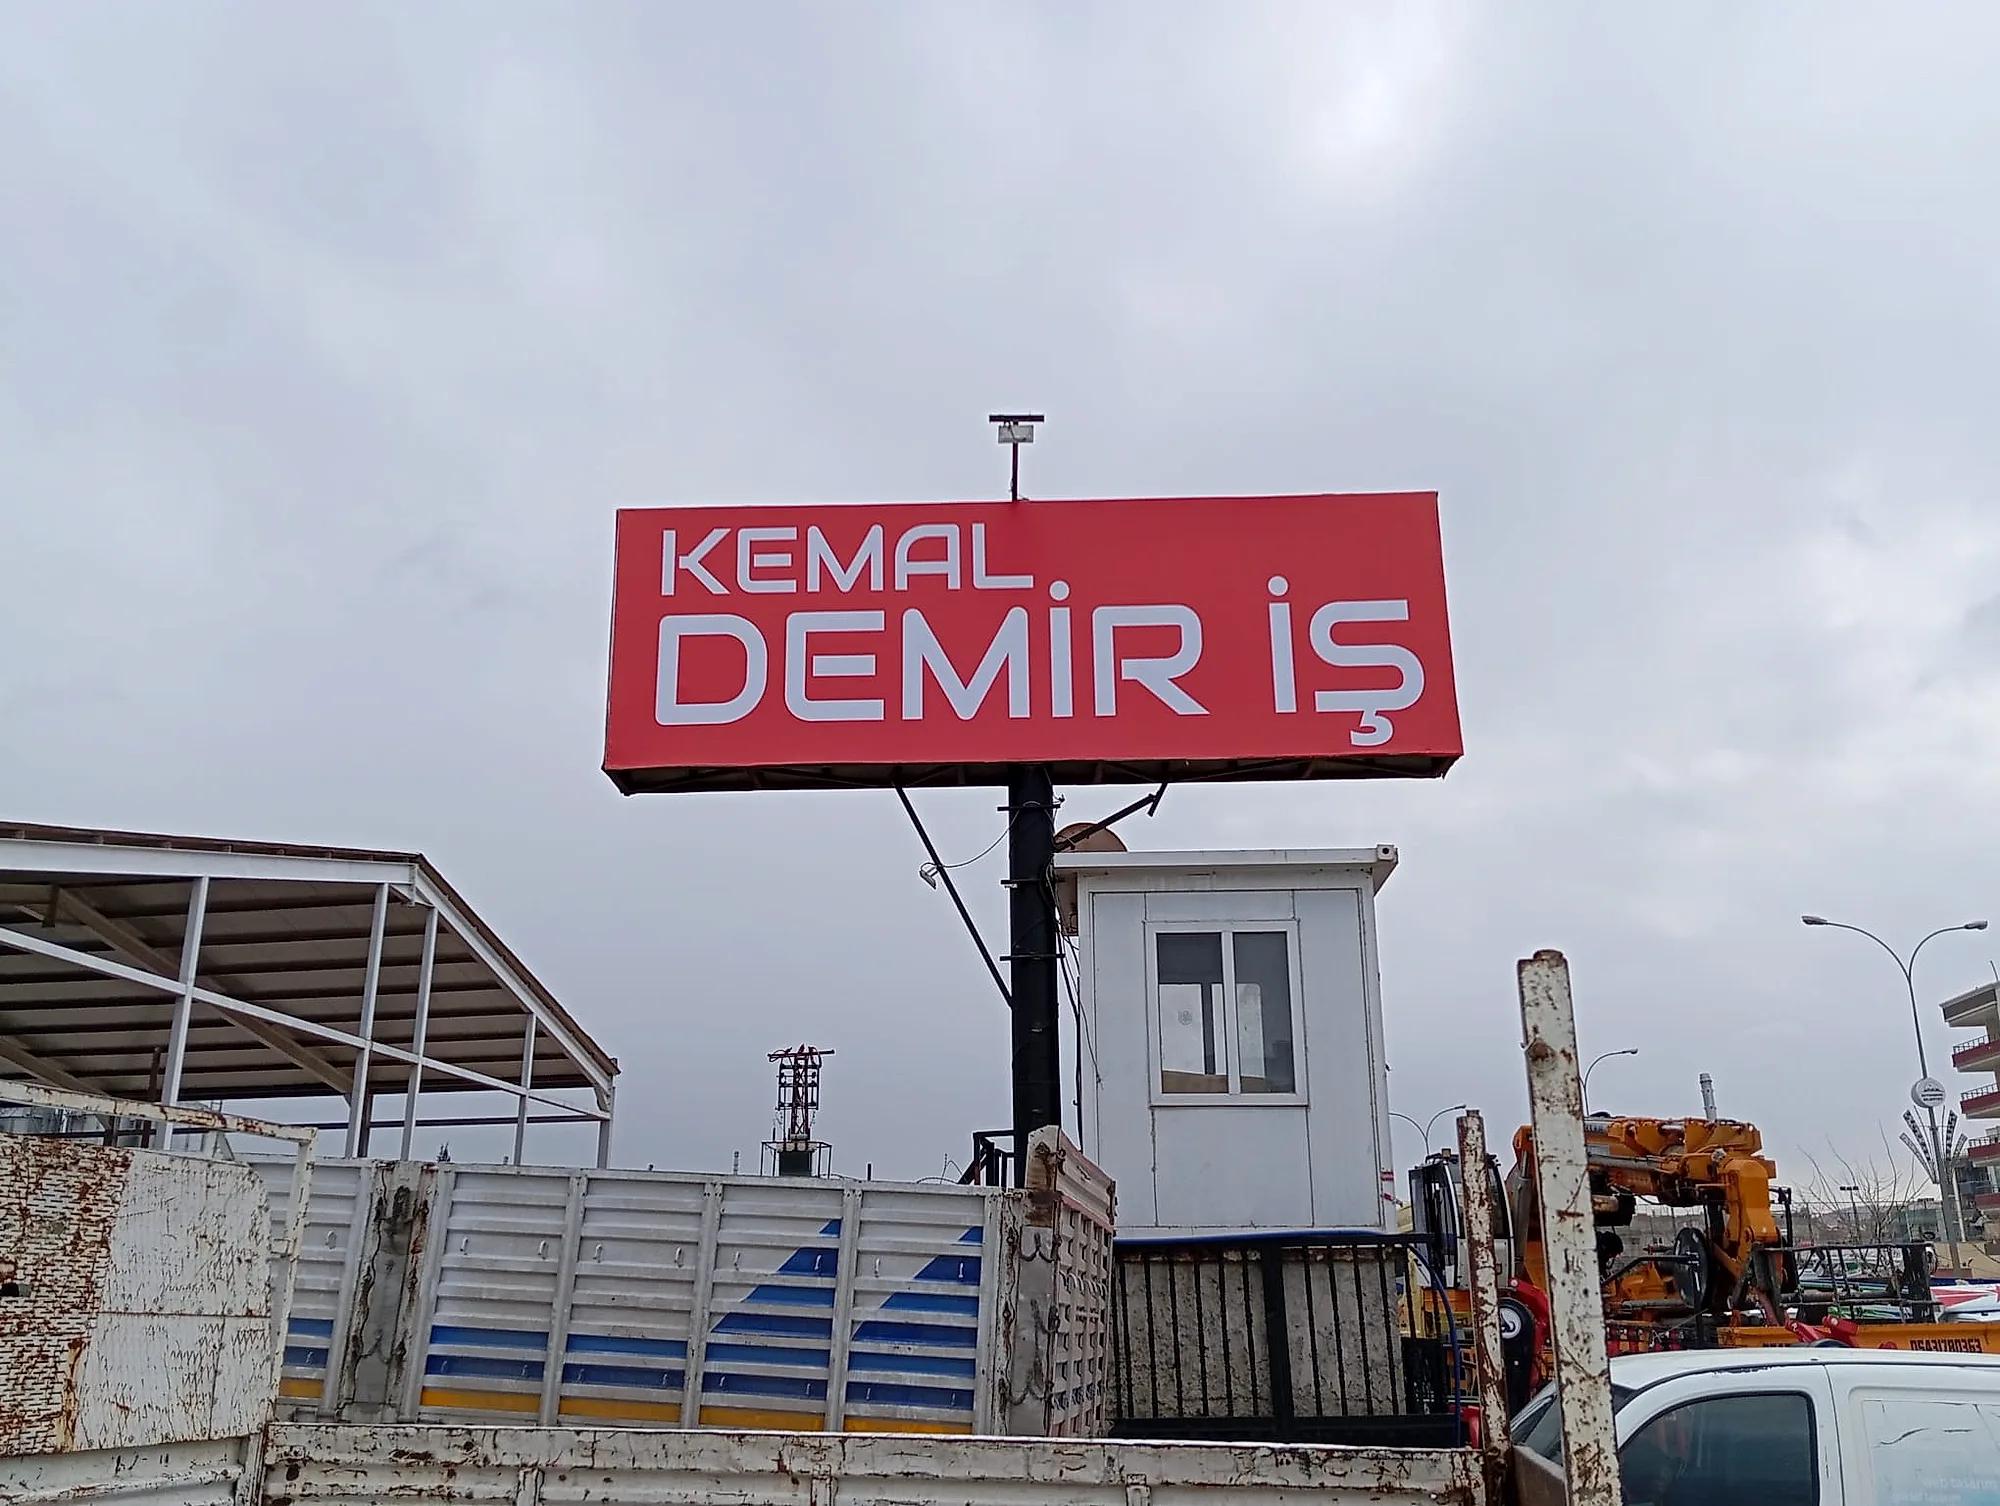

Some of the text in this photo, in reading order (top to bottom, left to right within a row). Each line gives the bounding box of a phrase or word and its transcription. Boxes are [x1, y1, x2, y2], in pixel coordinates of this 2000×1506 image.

[661, 523, 1034, 596] KEMAL
[655, 575, 1425, 746] DEMİR İŞ
